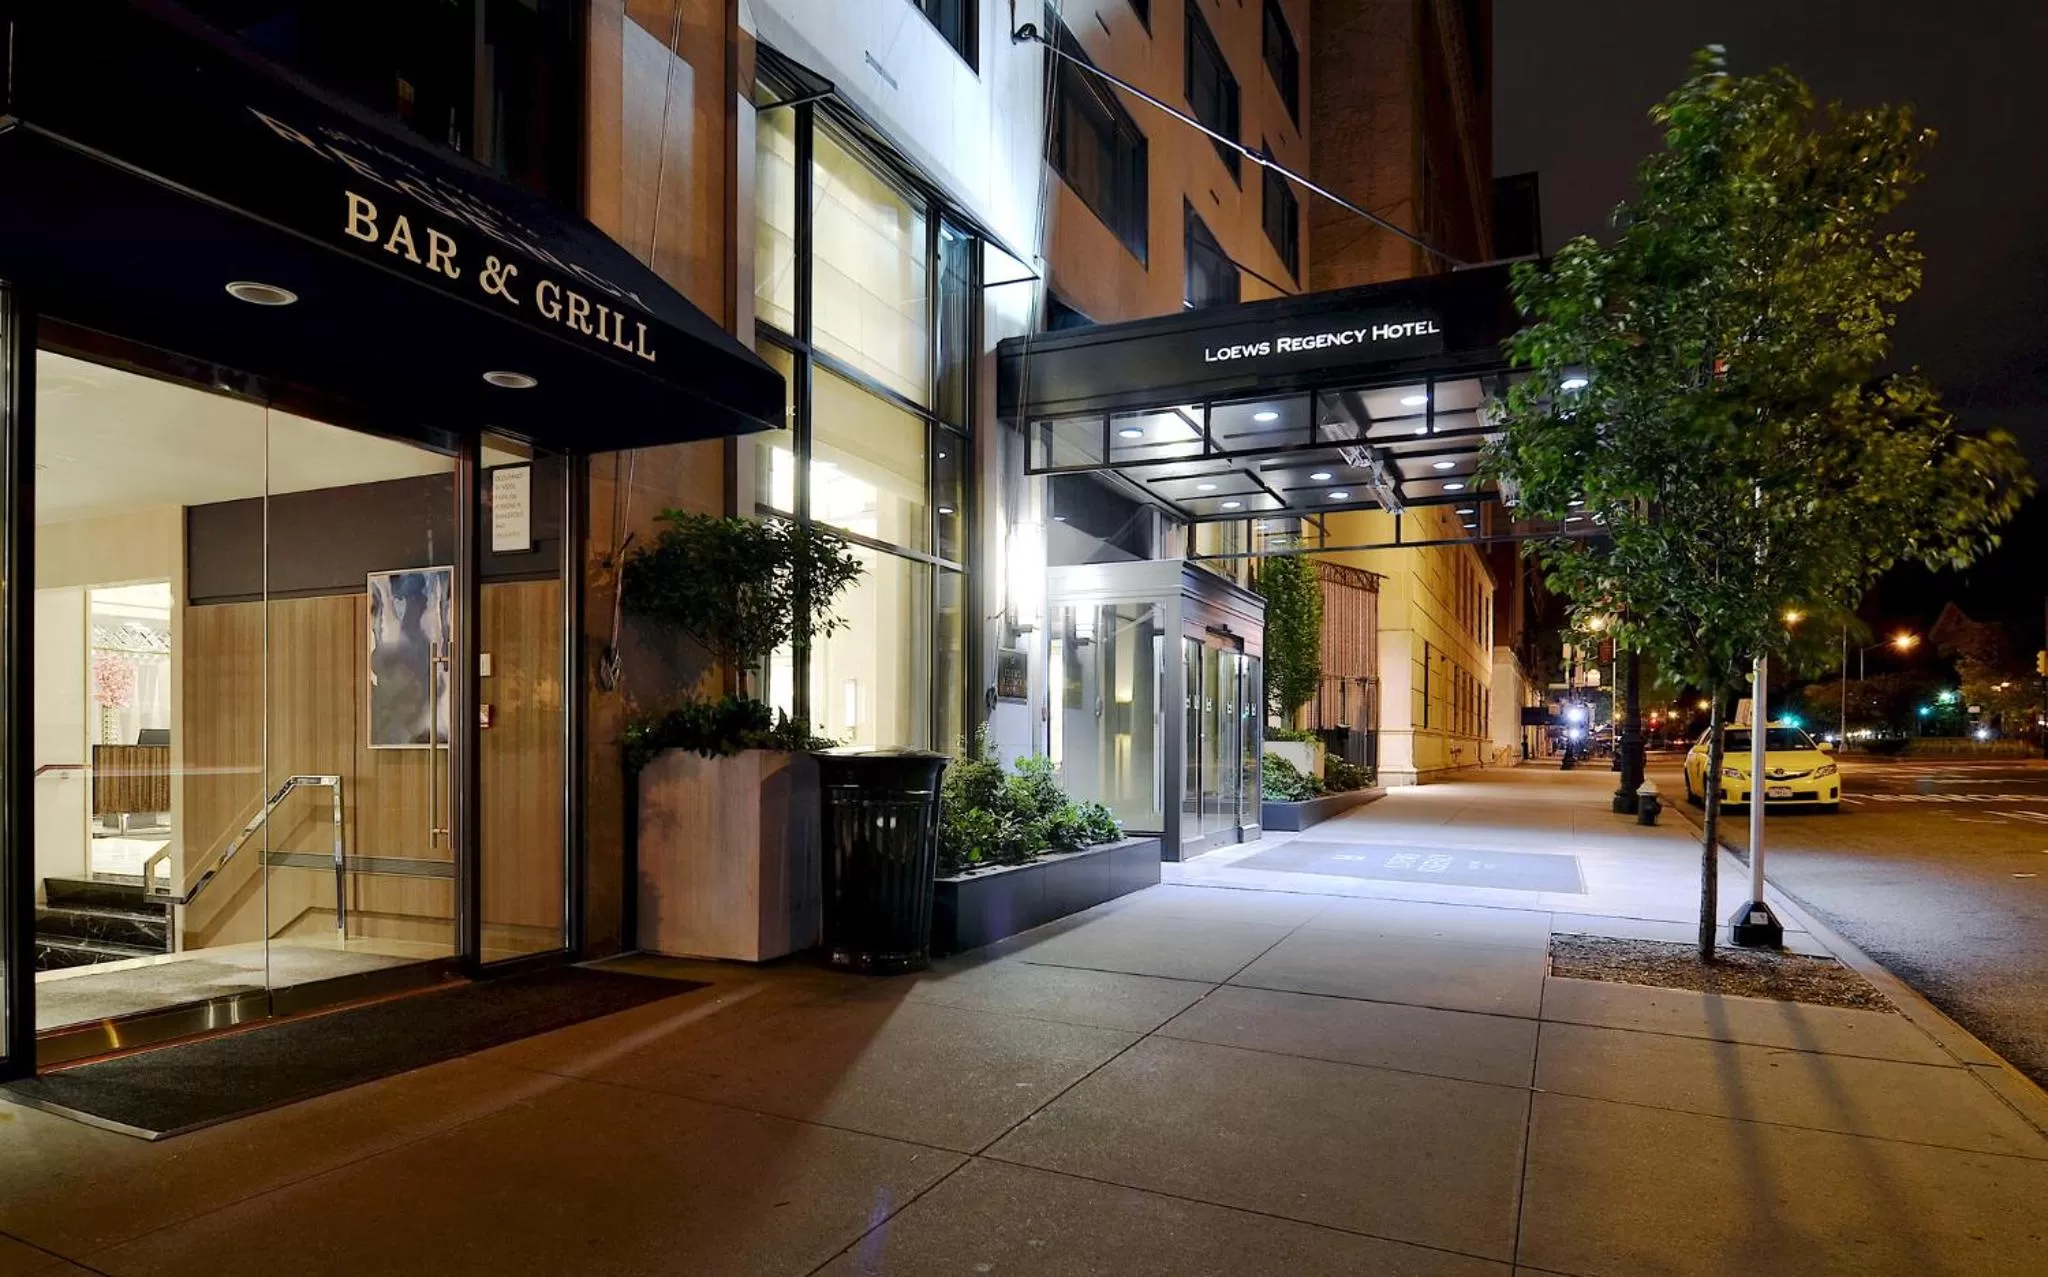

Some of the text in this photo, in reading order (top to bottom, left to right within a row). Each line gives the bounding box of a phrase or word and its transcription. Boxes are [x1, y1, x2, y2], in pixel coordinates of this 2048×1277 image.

[246, 104, 656, 314] REGENCY
[345, 191, 656, 361] BAR & GRILL
[1205, 321, 1440, 362] LOEWS REGENCY HOTEL
